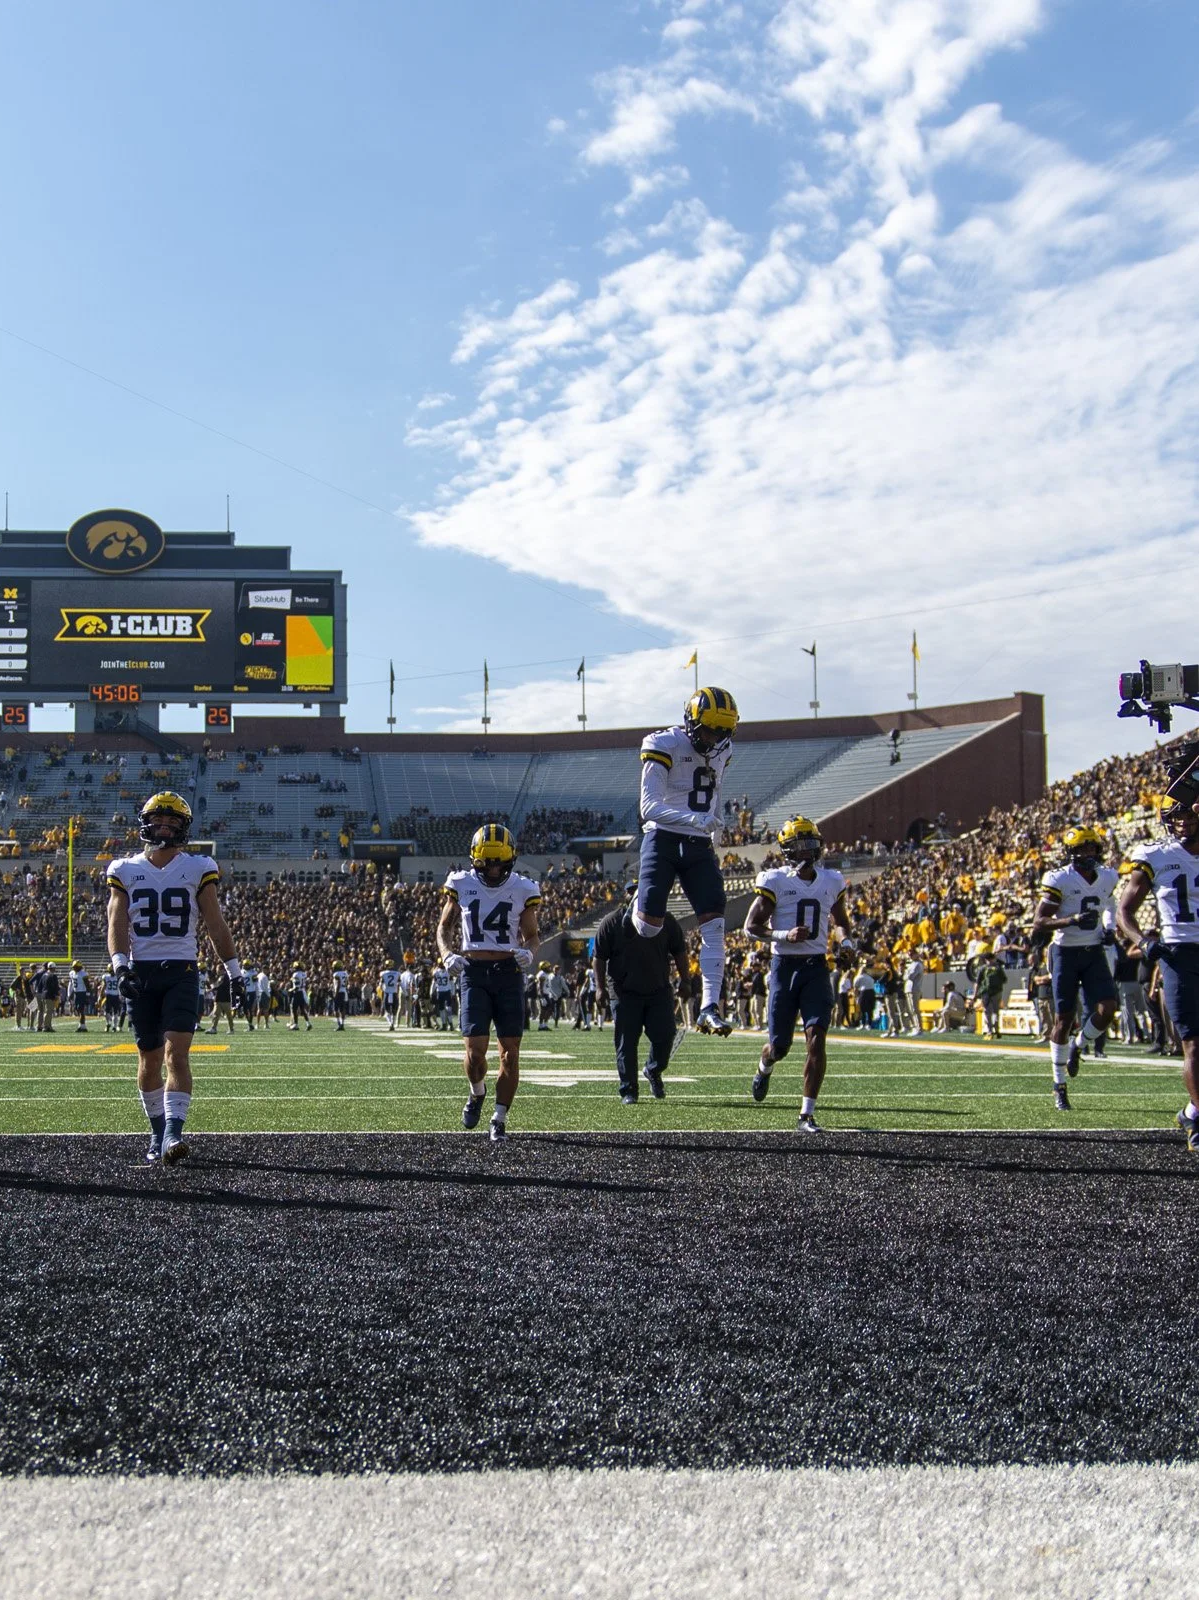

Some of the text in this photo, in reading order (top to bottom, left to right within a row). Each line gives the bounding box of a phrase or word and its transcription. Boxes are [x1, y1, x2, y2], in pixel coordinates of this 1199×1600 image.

[254, 594, 286, 603] StubHub
[8, 610, 15, 623] 1
[110, 615, 193, 636] I-CLUB
[92, 685, 139, 701] 45:06
[4, 707, 25, 724] 25
[208, 708, 228, 724] 25
[688, 766, 716, 812] 8
[1172, 874, 1199, 923] 1
[132, 888, 191, 937] 39
[468, 899, 513, 944] 14
[796, 899, 821, 940] 0
[1080, 896, 1100, 931] 6
[387, 975, 395, 987] 2
